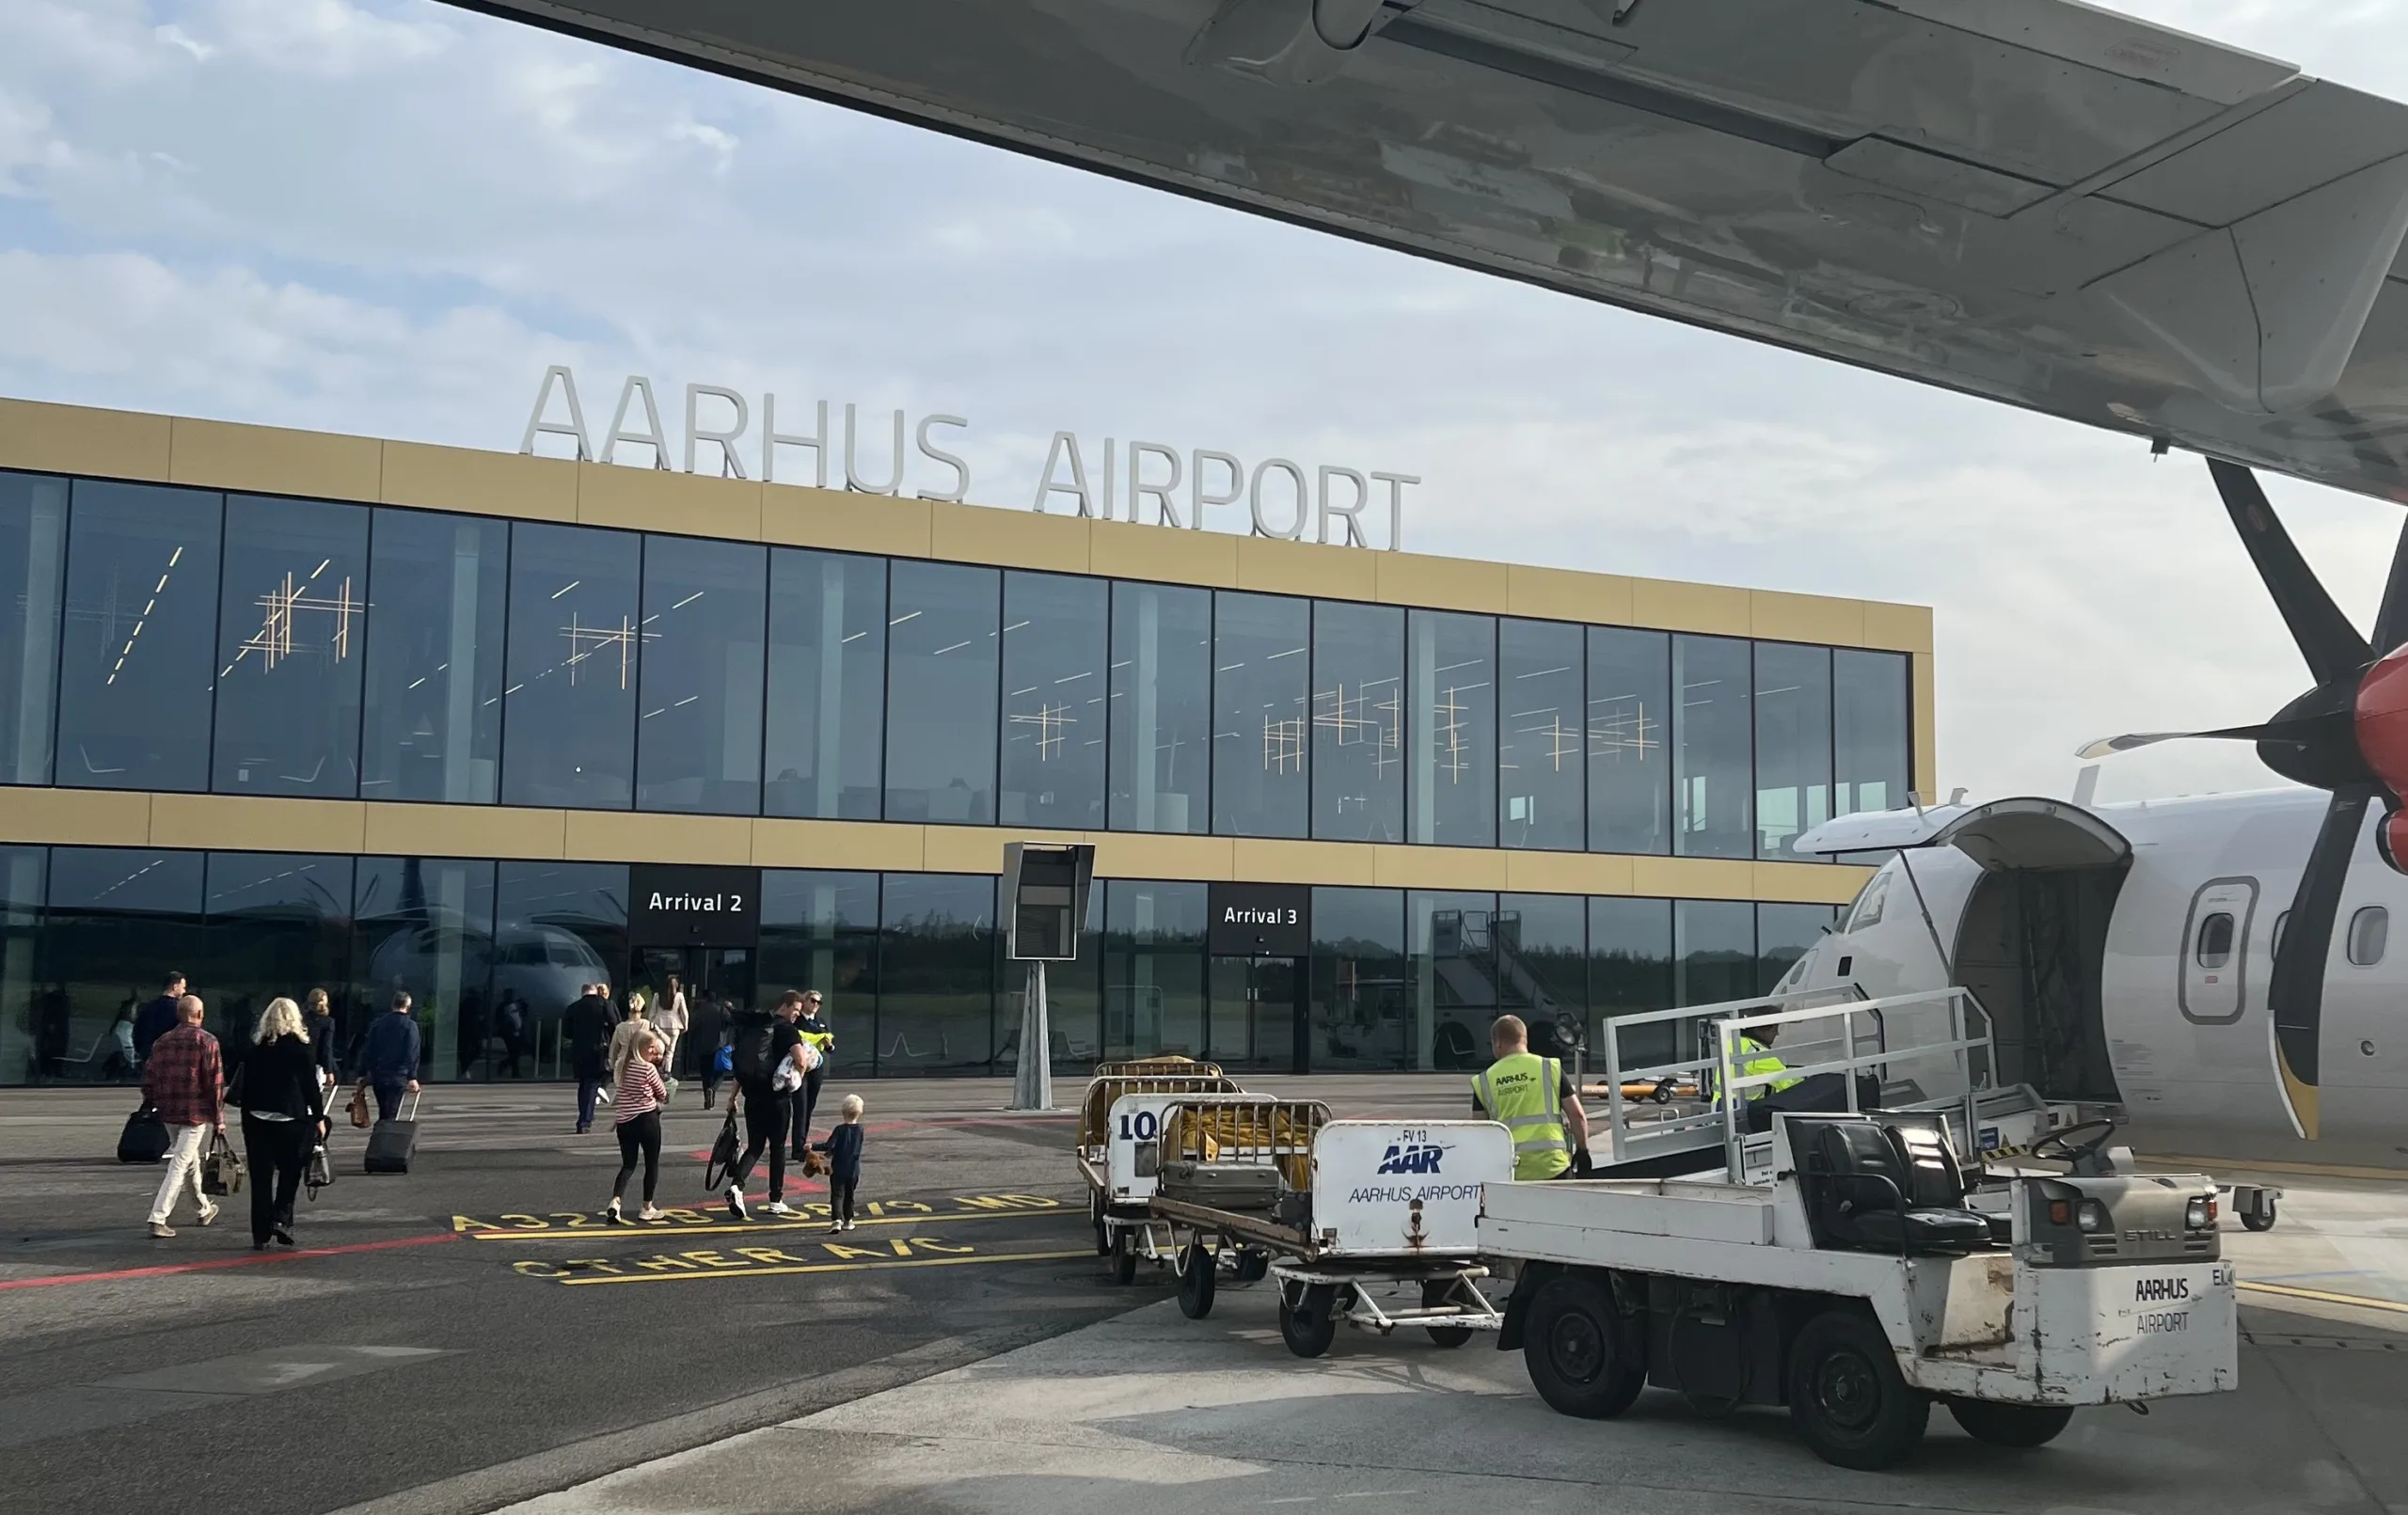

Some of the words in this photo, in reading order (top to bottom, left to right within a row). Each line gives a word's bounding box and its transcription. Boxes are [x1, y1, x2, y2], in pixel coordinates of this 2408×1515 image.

[519, 365, 970, 501] AARHUS
[1033, 431, 1421, 551] AIRPORT
[649, 892, 721, 911] Arrival
[730, 895, 741, 911] 2
[1225, 907, 1280, 923] Arrival
[1288, 909, 1297, 924] 3
[1496, 1073, 1529, 1086] AARHUS
[1497, 1084, 1529, 1097] AIRPORT
[1119, 1111, 1157, 1140] 10
[1403, 1130, 1416, 1142] FV
[1418, 1130, 1427, 1142] 13
[1377, 1145, 1443, 1175] AAR
[1348, 1187, 1412, 1203] AARHUS
[1416, 1185, 1481, 1201] AIRPORT
[820, 1238, 975, 1260] A/C
[2135, 1278, 2189, 1302] AARHUS
[2136, 1312, 2189, 1334] AIRPORT
